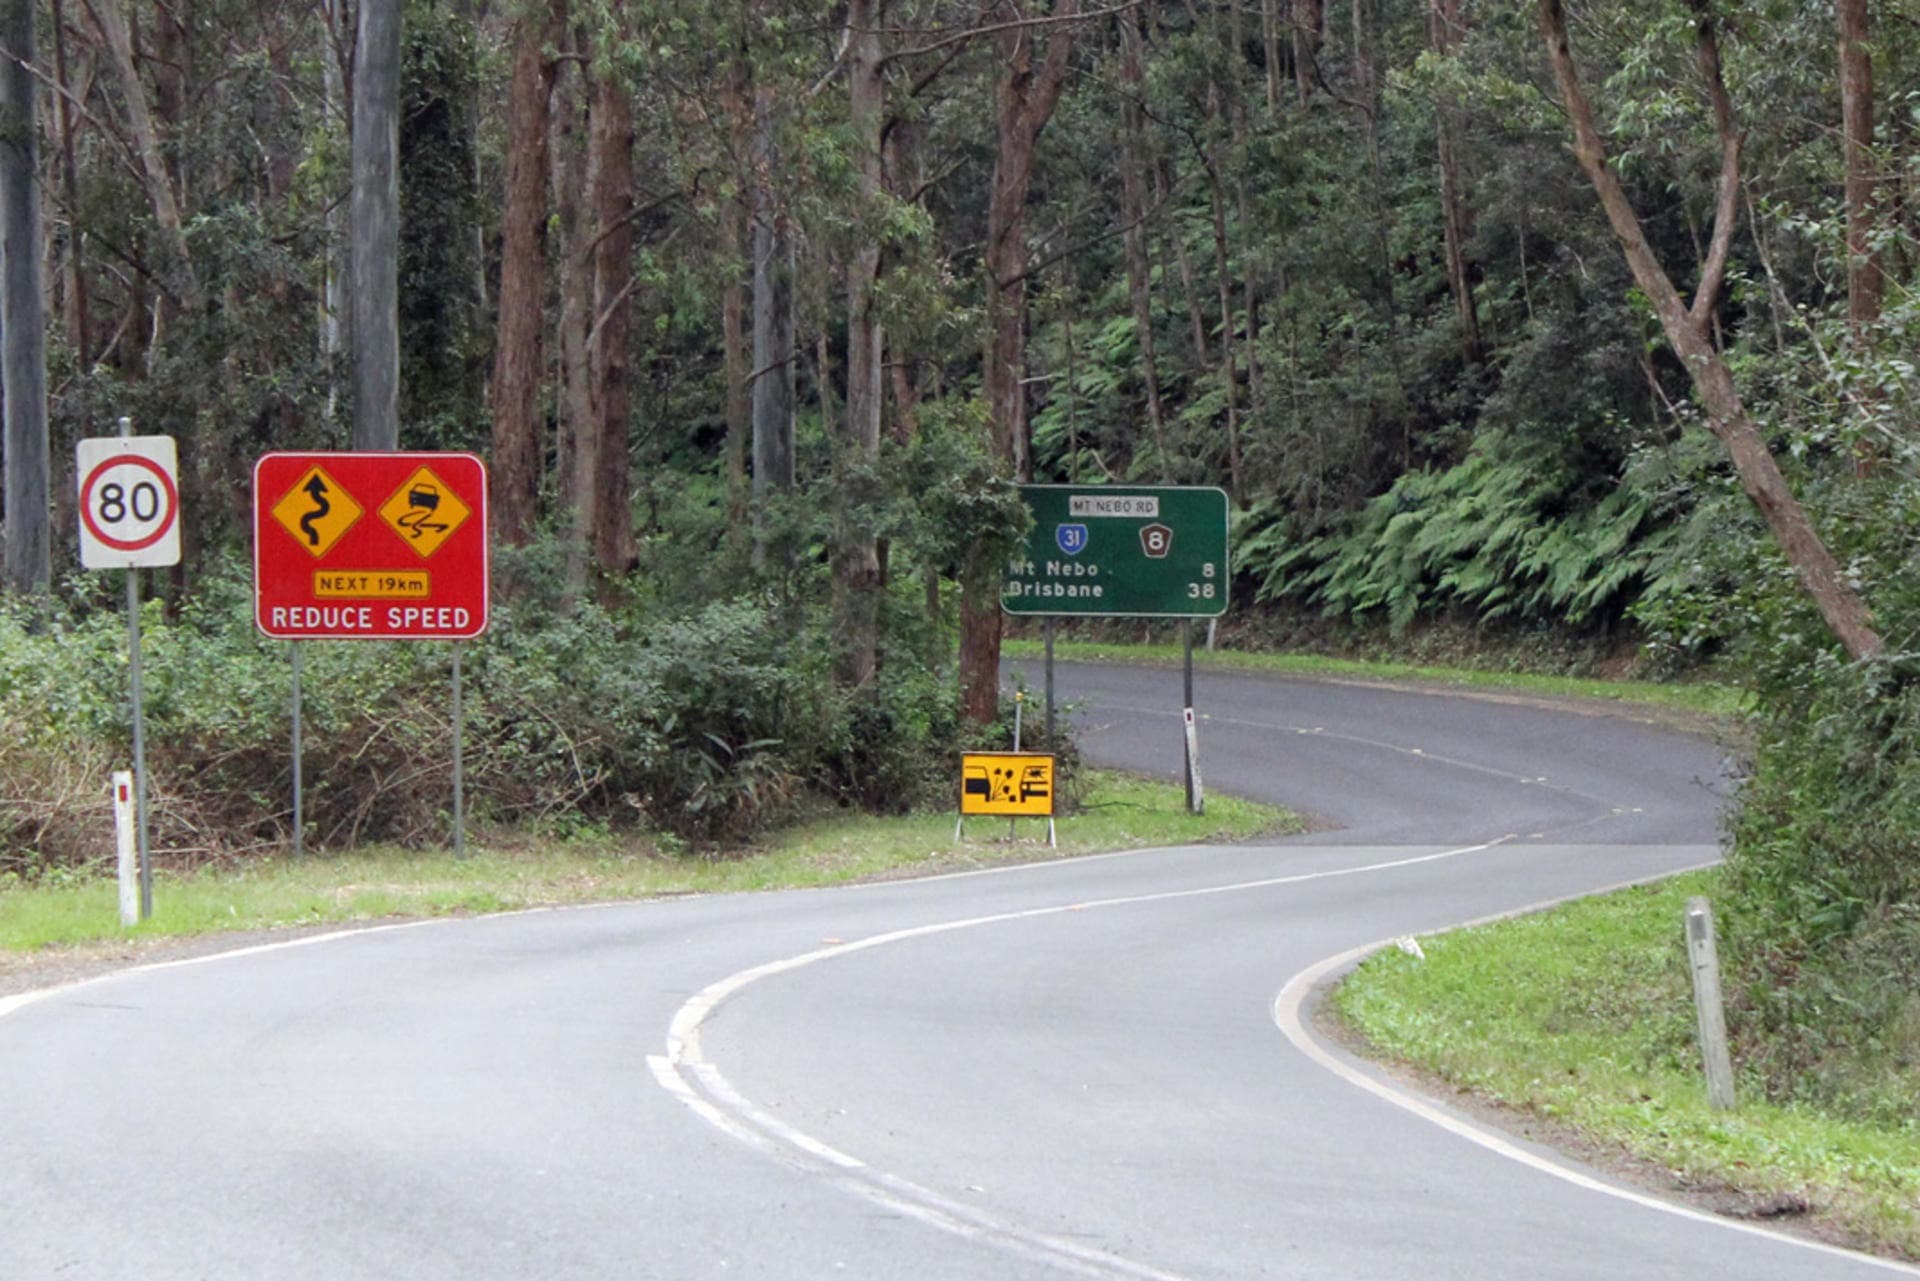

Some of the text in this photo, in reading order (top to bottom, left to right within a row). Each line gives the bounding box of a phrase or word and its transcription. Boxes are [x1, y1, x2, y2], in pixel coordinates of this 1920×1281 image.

[99, 481, 159, 523] 80
[1073, 501, 1154, 512] MT NEBO RD
[1064, 530, 1080, 547] 31
[1149, 531, 1164, 550] 8
[1009, 561, 1215, 578] Mt Nebo 8
[320, 577, 423, 591] NEXT 19km
[1009, 581, 1216, 599] Brisbane 38
[272, 607, 470, 629] REDUCE SPEED
